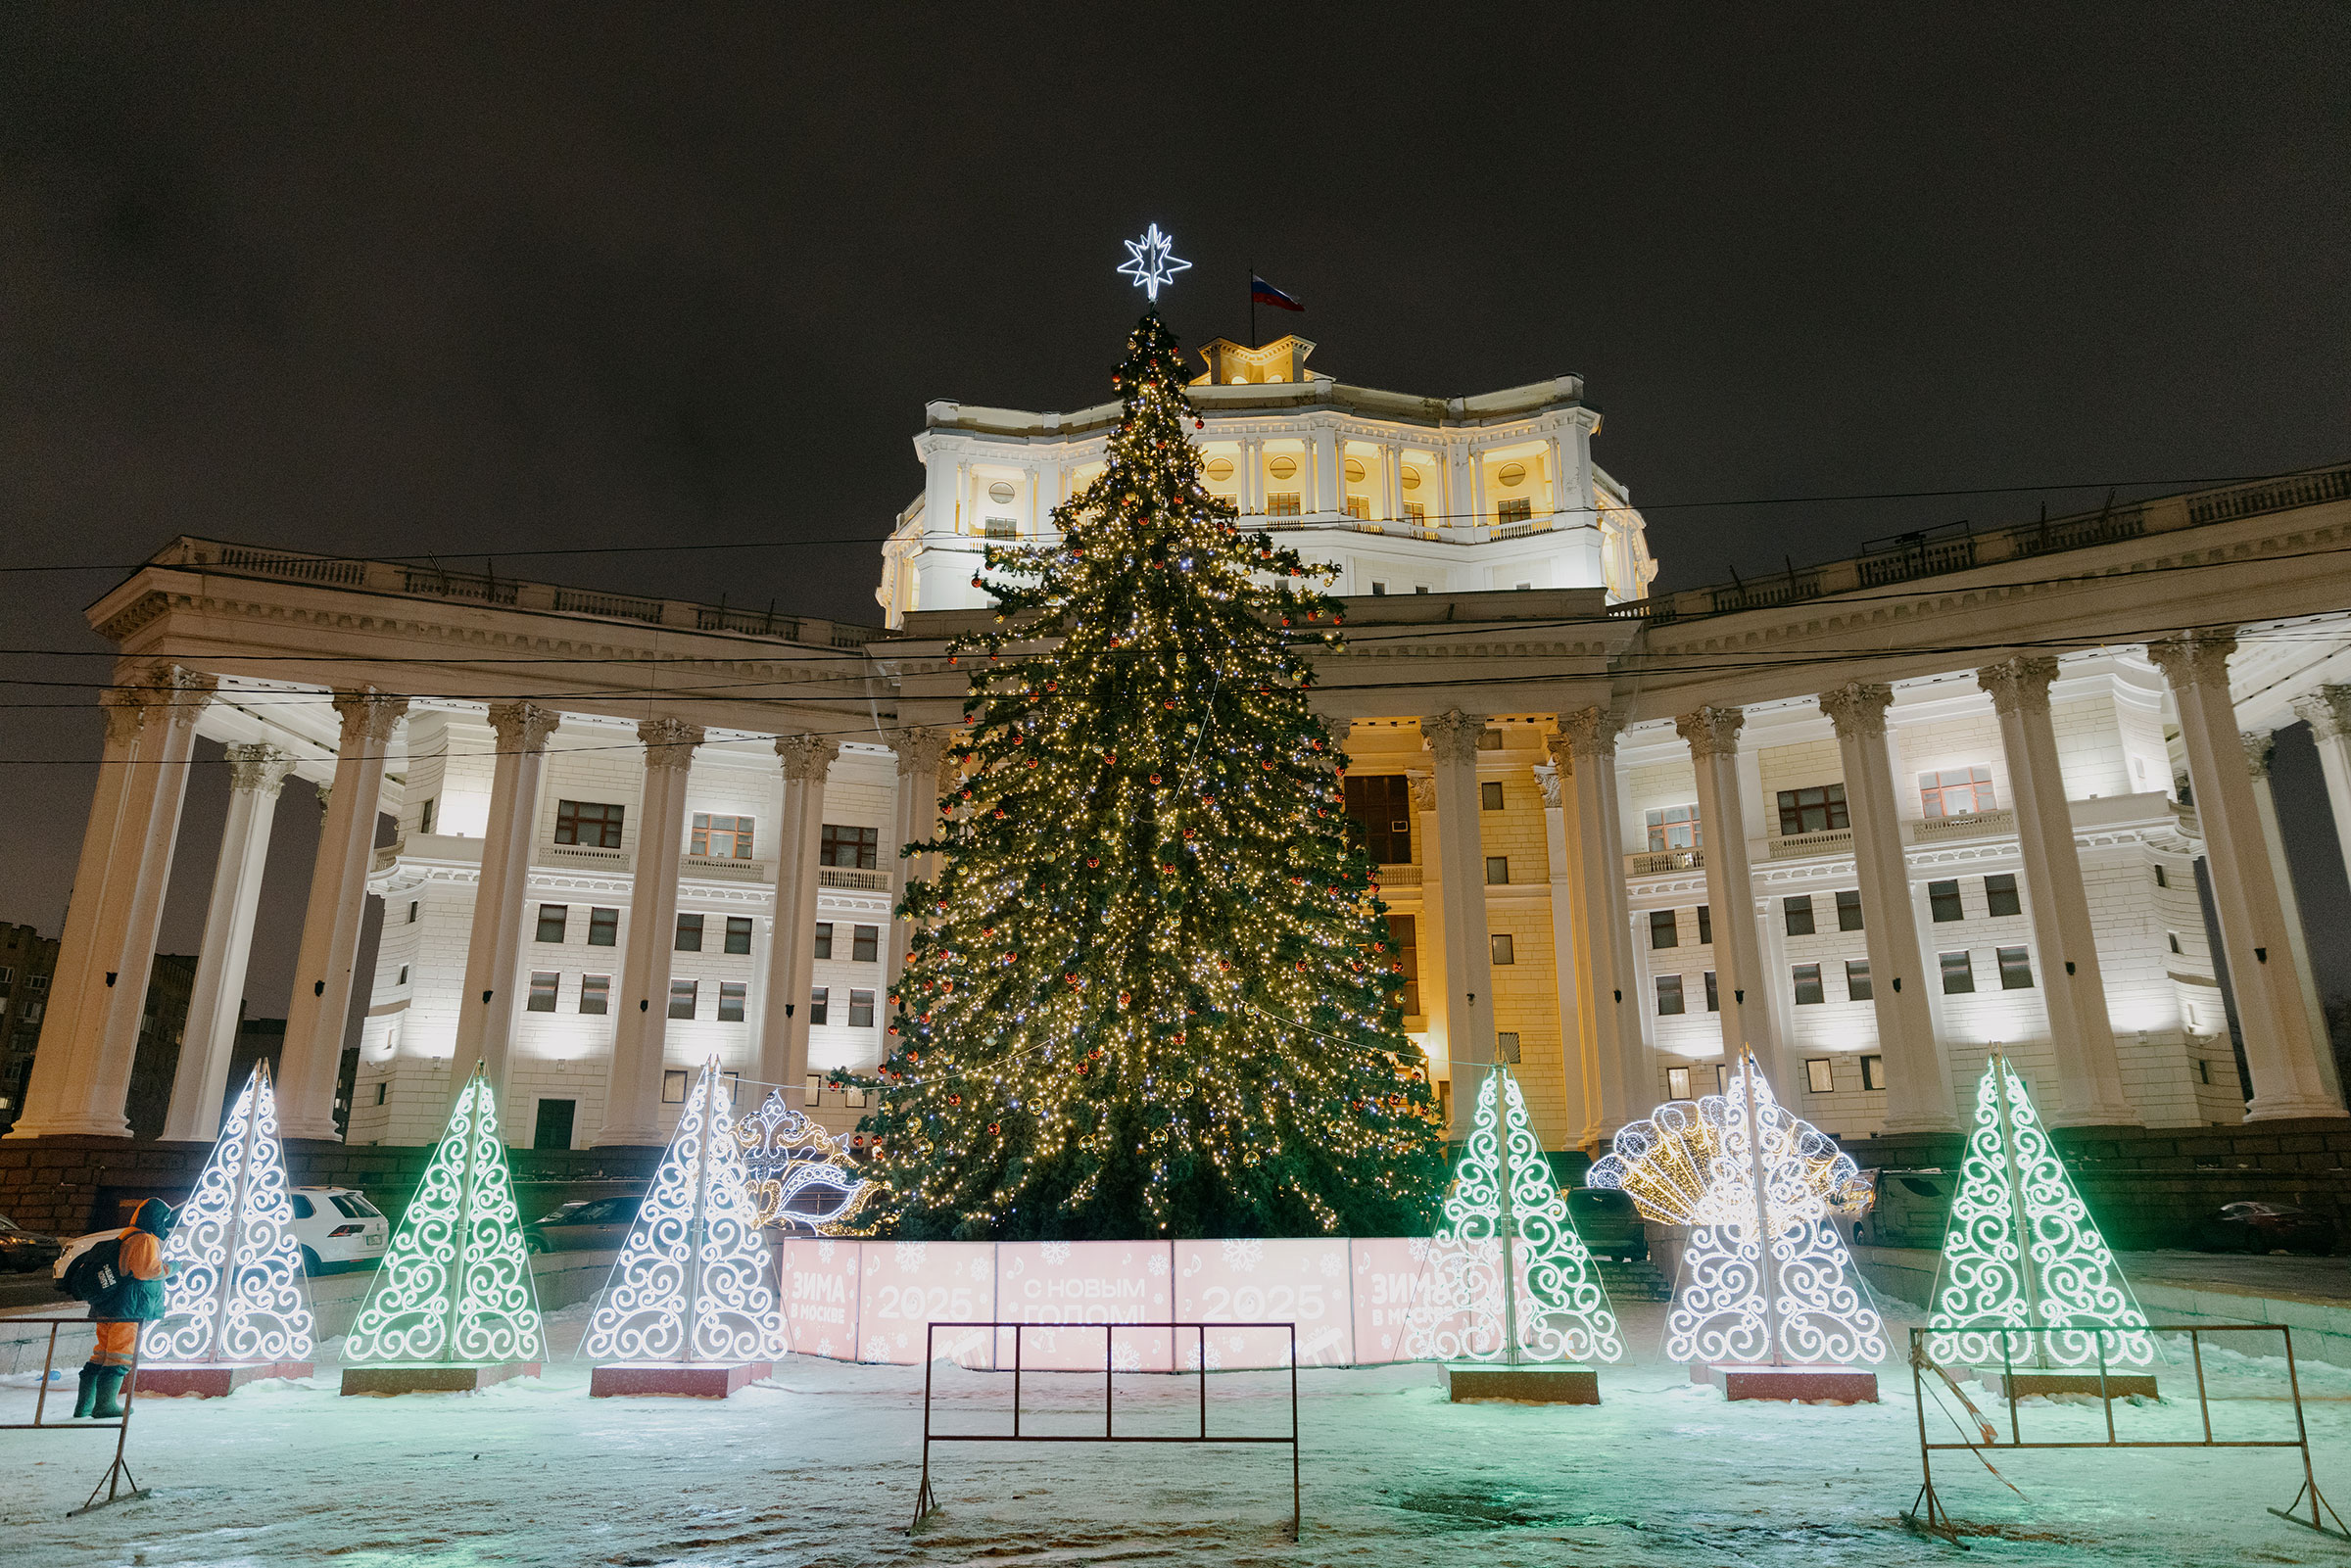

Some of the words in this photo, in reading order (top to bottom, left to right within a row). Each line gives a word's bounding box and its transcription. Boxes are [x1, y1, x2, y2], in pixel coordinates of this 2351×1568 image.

[792, 1271, 845, 1304] ЗИМА
[878, 1285, 973, 1321] 2025
[1024, 1279, 1041, 1299] С
[1047, 1278, 1145, 1299] НОВЫМ
[1202, 1285, 1325, 1321] 2025
[1370, 1273, 1452, 1304] ЗИМА
[791, 1303, 798, 1318] В
[800, 1304, 845, 1324] МОСКВЕ
[1372, 1308, 1383, 1326] В
